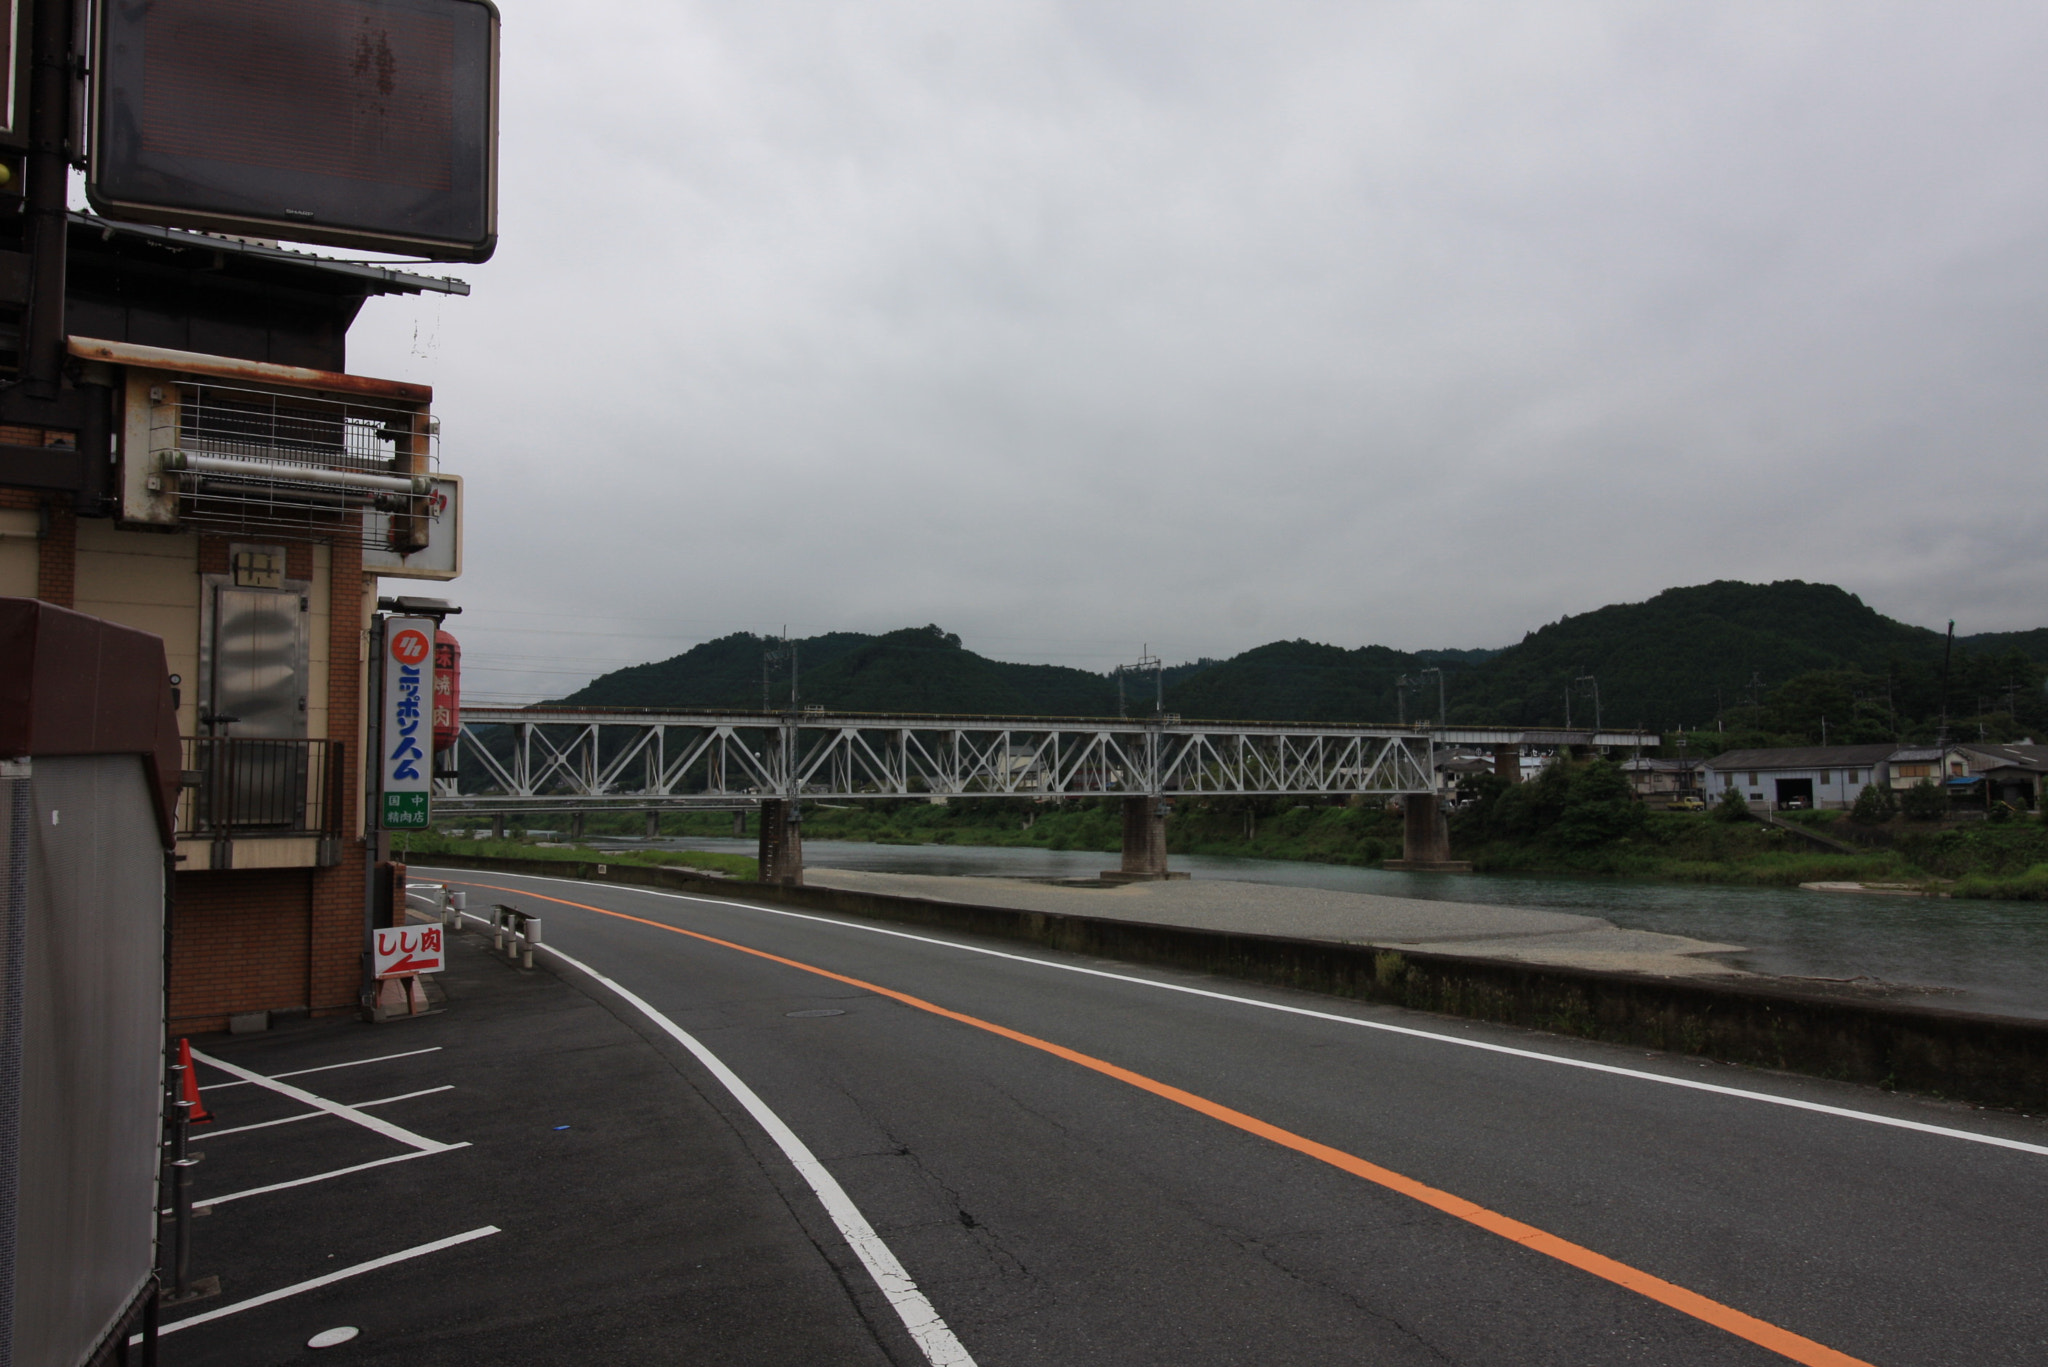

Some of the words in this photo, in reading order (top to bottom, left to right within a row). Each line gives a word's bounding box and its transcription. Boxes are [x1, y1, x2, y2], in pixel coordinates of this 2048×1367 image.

[391, 664, 423, 780] ニッポンハム
[387, 810, 424, 823] 精肉店
[378, 927, 442, 956] しし肉
